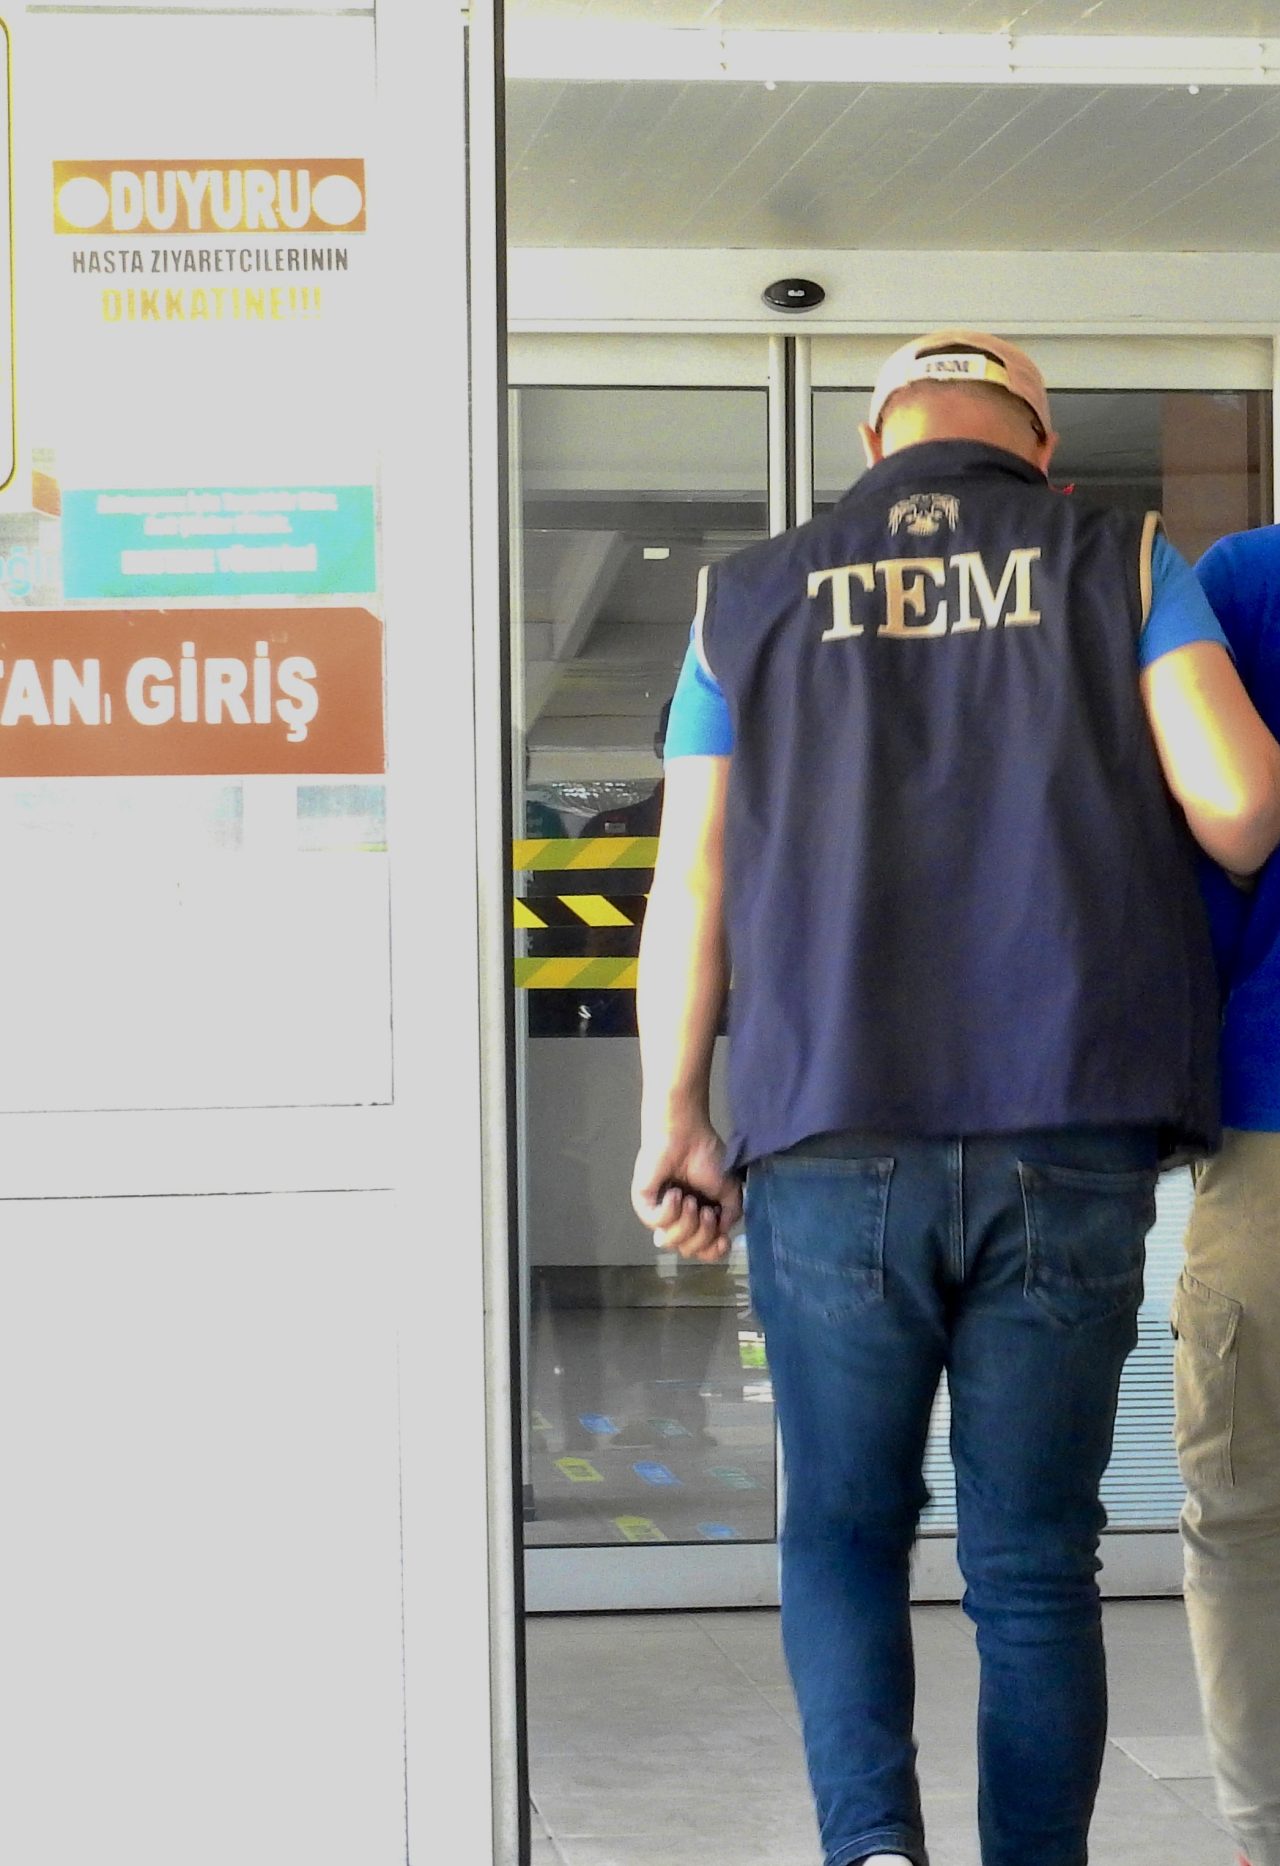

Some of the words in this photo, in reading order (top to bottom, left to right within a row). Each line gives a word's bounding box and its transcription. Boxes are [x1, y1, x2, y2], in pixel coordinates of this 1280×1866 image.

[111, 169, 310, 230] DUYURU
[72, 250, 144, 273] HASTA
[806, 547, 1042, 643] TEM
[0, 657, 101, 726] AN
[125, 640, 320, 743] GİRİŞ
